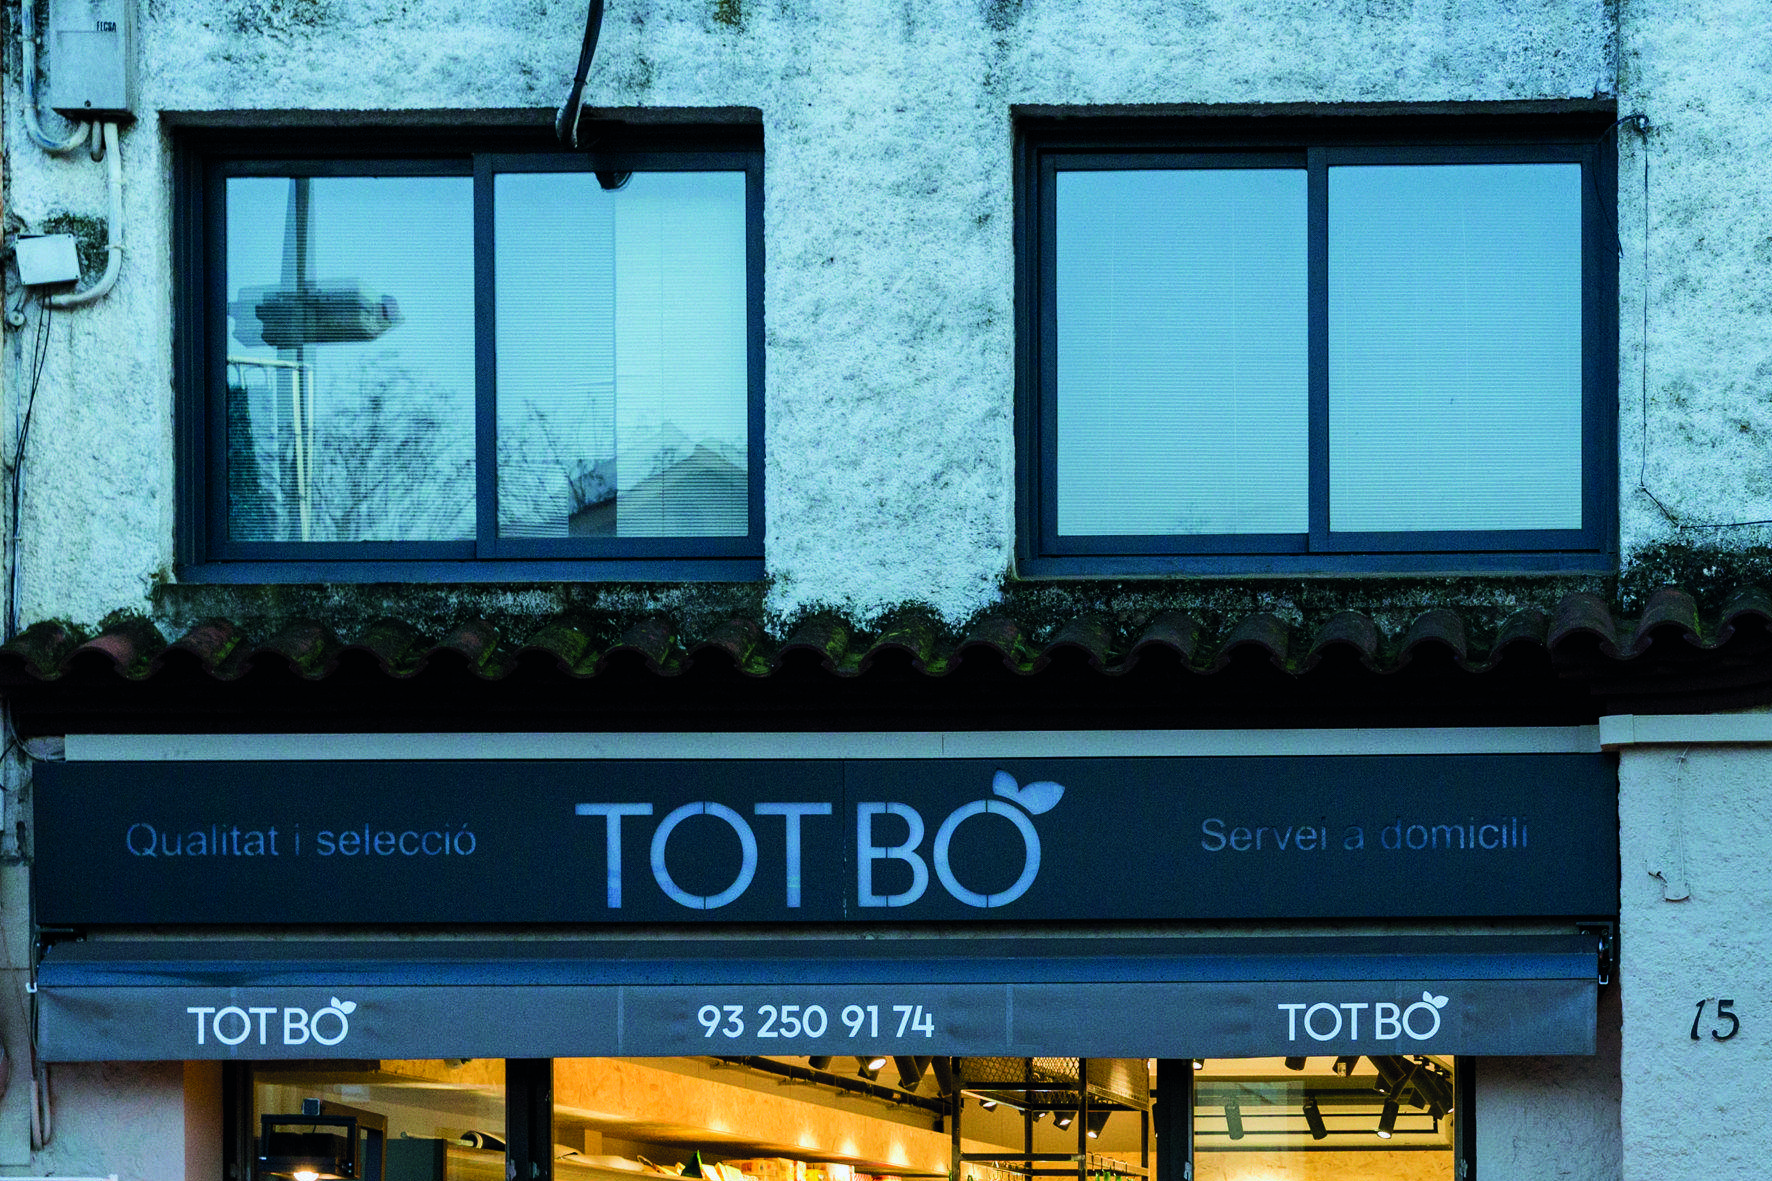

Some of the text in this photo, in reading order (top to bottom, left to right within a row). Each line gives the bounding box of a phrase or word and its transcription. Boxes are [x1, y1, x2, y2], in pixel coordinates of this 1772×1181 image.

[125, 823, 478, 859] Qualitat i selecció
[1201, 816, 1529, 852] Servei a domicili
[575, 802, 832, 910] TOT
[188, 1006, 282, 1045] TOT
[698, 1005, 935, 1038] 93 250 91 74
[1278, 1003, 1372, 1042] TOT
[1690, 999, 1740, 1042] 15
